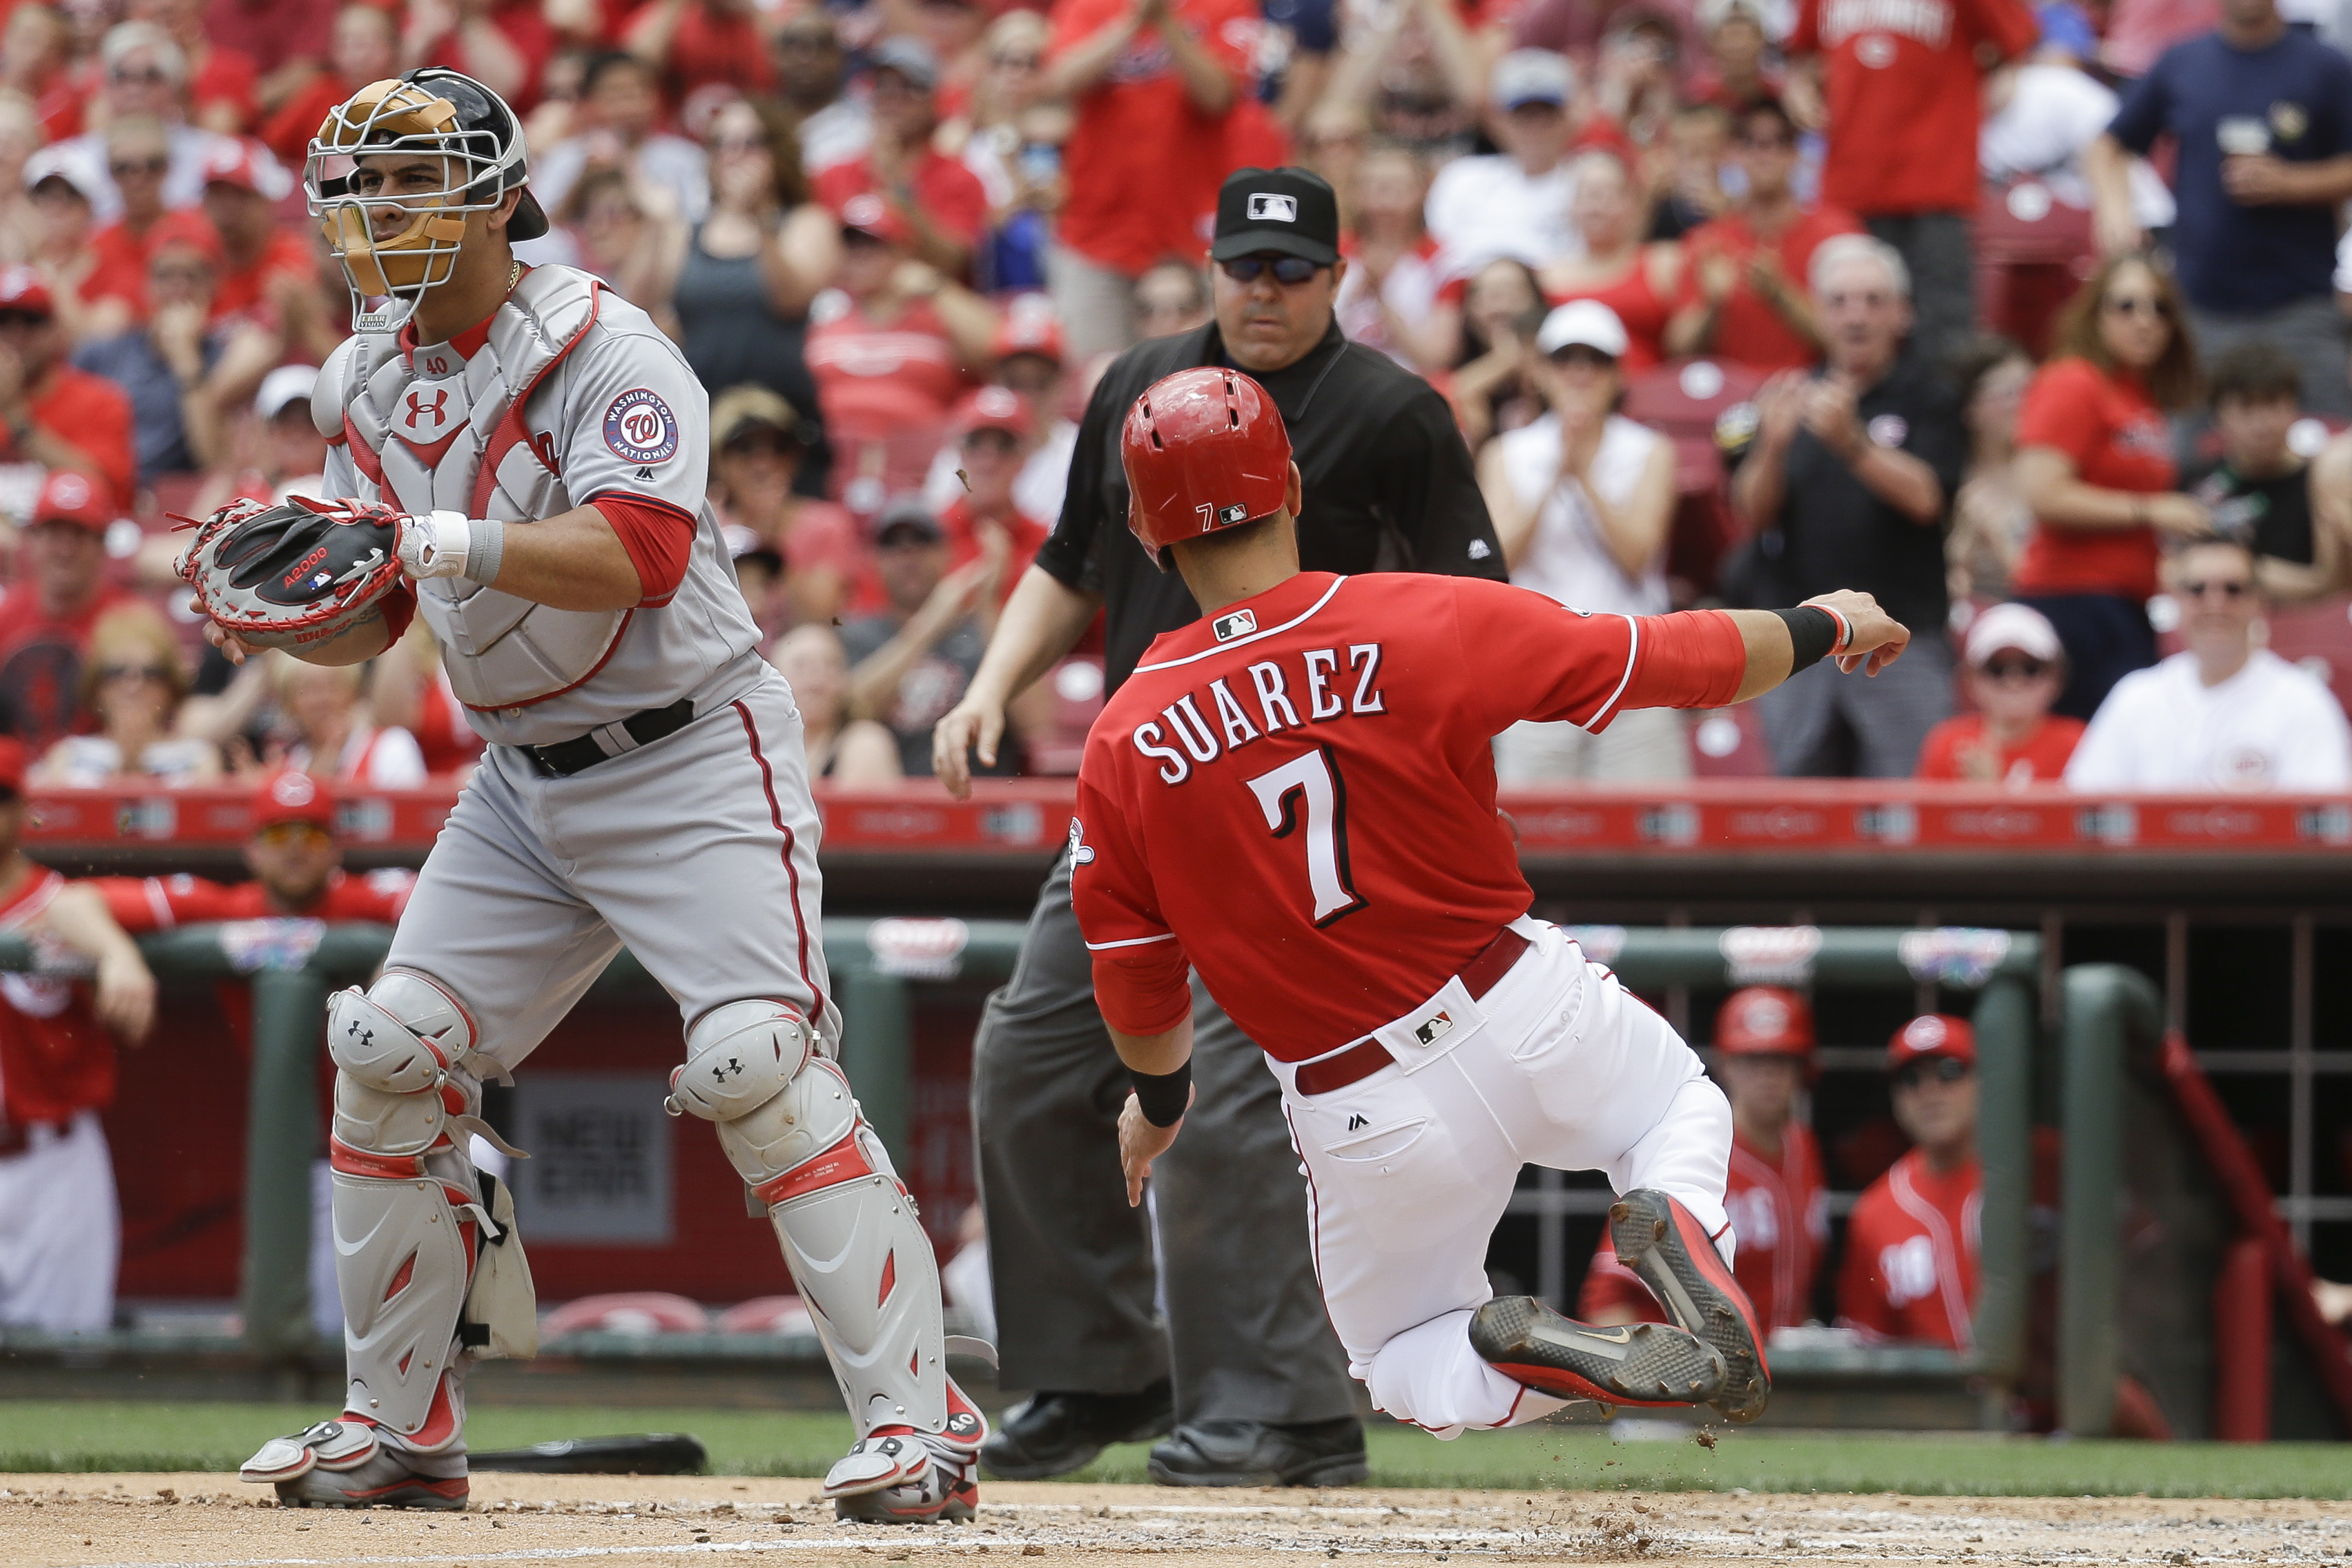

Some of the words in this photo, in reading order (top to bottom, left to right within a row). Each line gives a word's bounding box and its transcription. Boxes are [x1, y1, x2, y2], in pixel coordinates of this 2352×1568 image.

[425, 355, 448, 375] 40
[608, 391, 673, 424] WASHINGTON
[613, 441, 673, 460] NATIONALS
[1195, 502, 1214, 533] 7
[284, 547, 329, 589] A2000
[1133, 642, 1386, 786] SUAREZ
[1245, 745, 1370, 929] 7
[949, 1413, 975, 1432] 40
